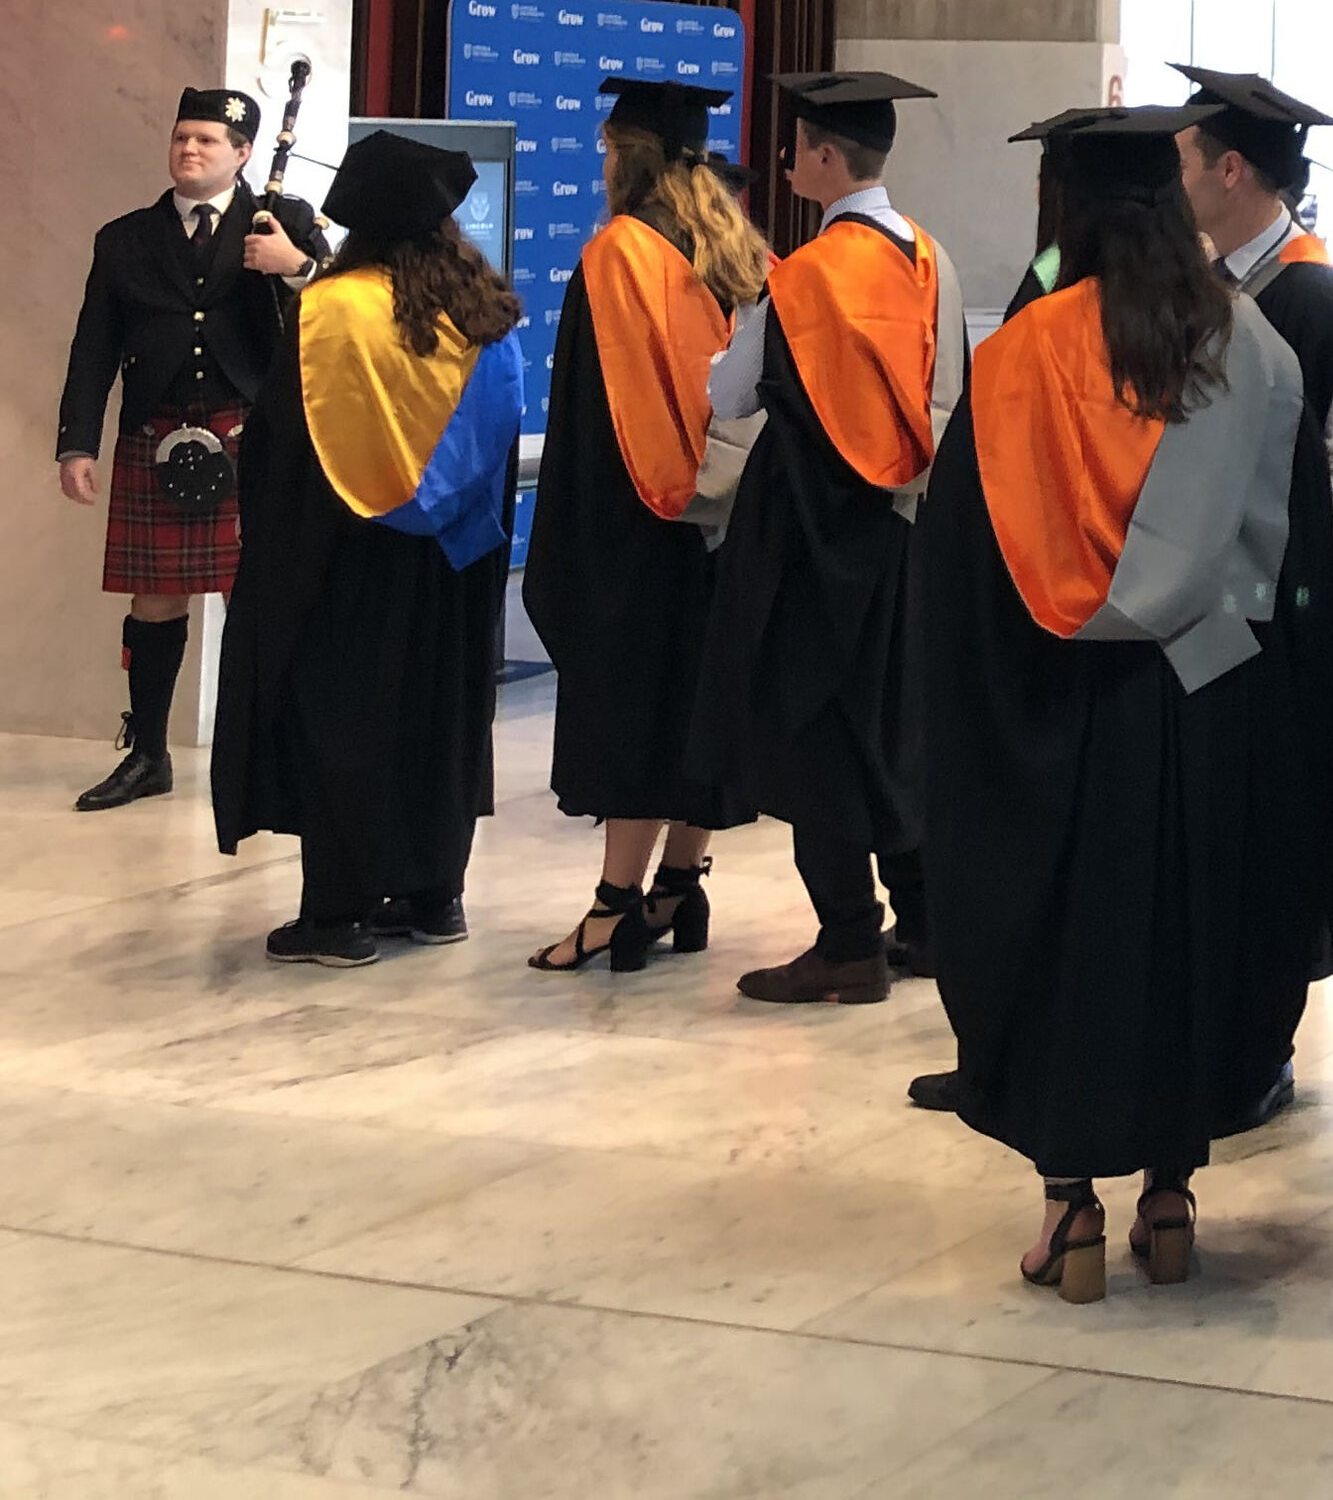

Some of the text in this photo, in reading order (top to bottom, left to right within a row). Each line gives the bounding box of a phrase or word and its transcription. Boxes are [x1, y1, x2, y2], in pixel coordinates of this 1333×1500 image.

[468, 0, 496, 17] Grow
[558, 9, 583, 26] Grow
[640, 17, 664, 33] Grow
[713, 23, 735, 38] Grow
[513, 49, 540, 65] Grow
[599, 55, 623, 71] Grow
[677, 60, 699, 75] Grow
[465, 90, 494, 107] Grow
[556, 95, 581, 110] Grow
[553, 181, 578, 196] Grow
[515, 228, 534, 241] row
